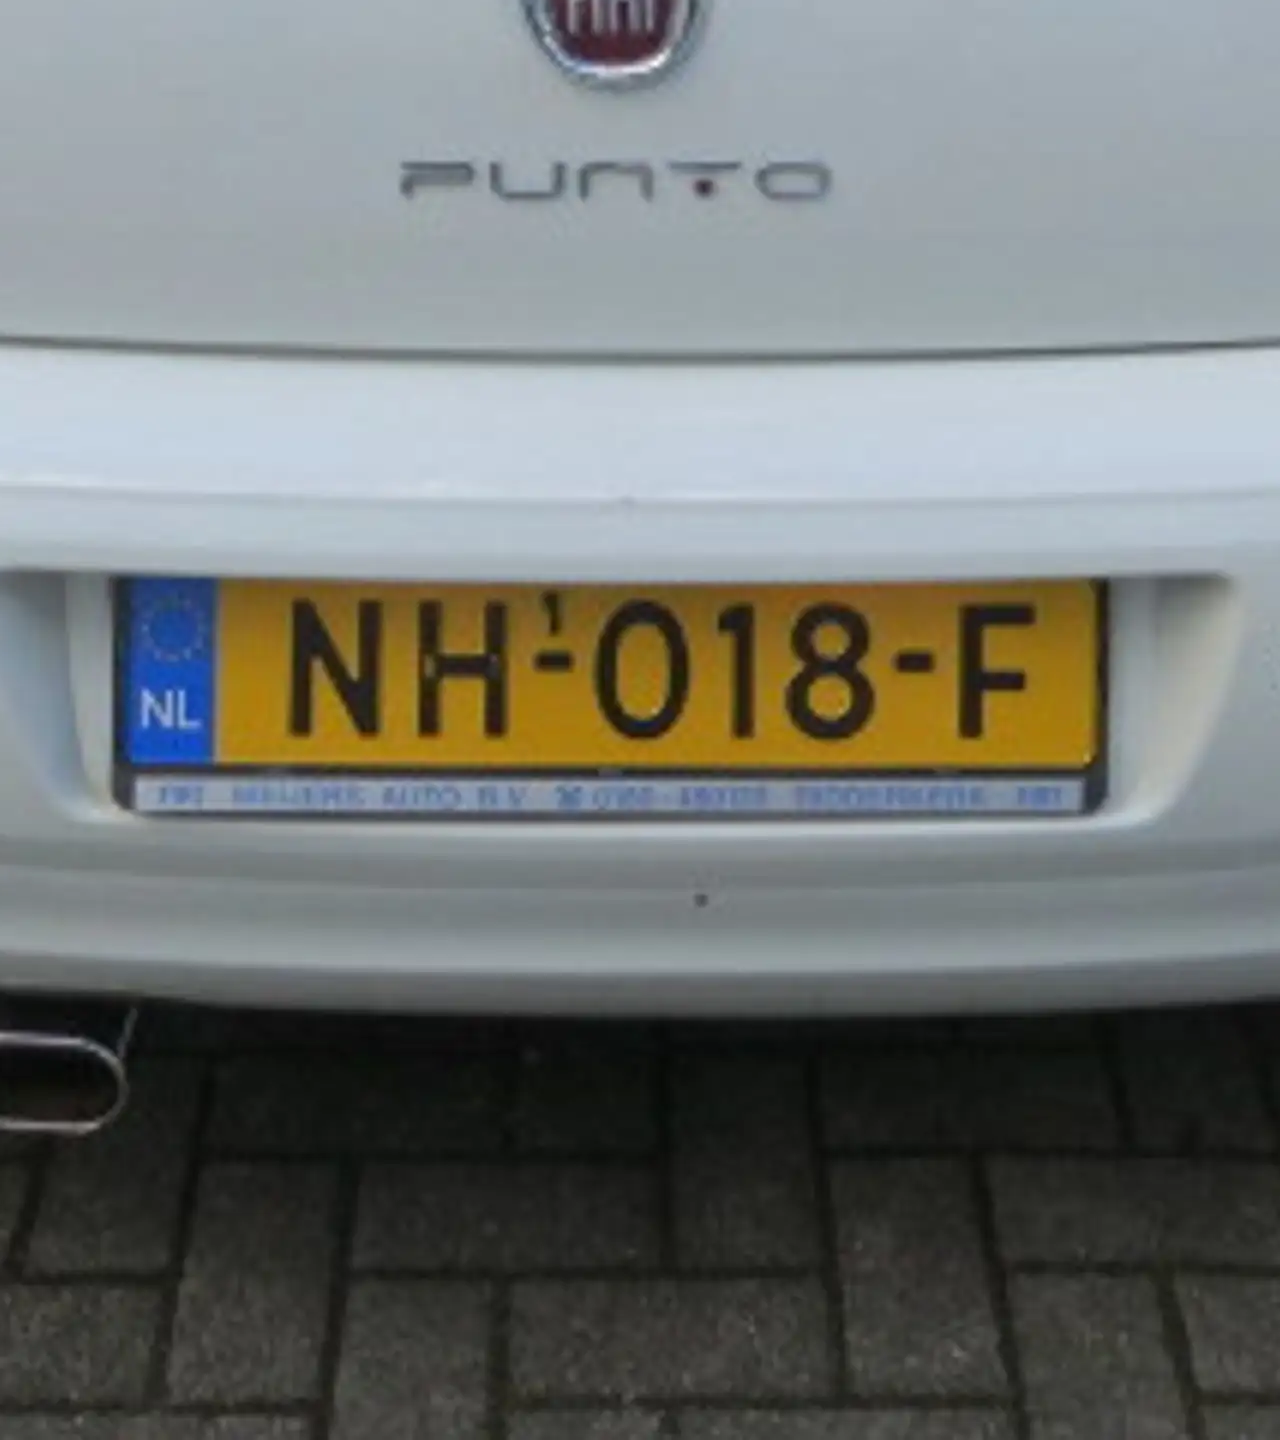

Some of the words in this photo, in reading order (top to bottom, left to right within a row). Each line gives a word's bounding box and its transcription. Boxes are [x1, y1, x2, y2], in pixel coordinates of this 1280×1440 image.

[399, 161, 833, 200] PUNTO
[286, 598, 1037, 740] NH-018-F
[141, 689, 202, 730] NL
